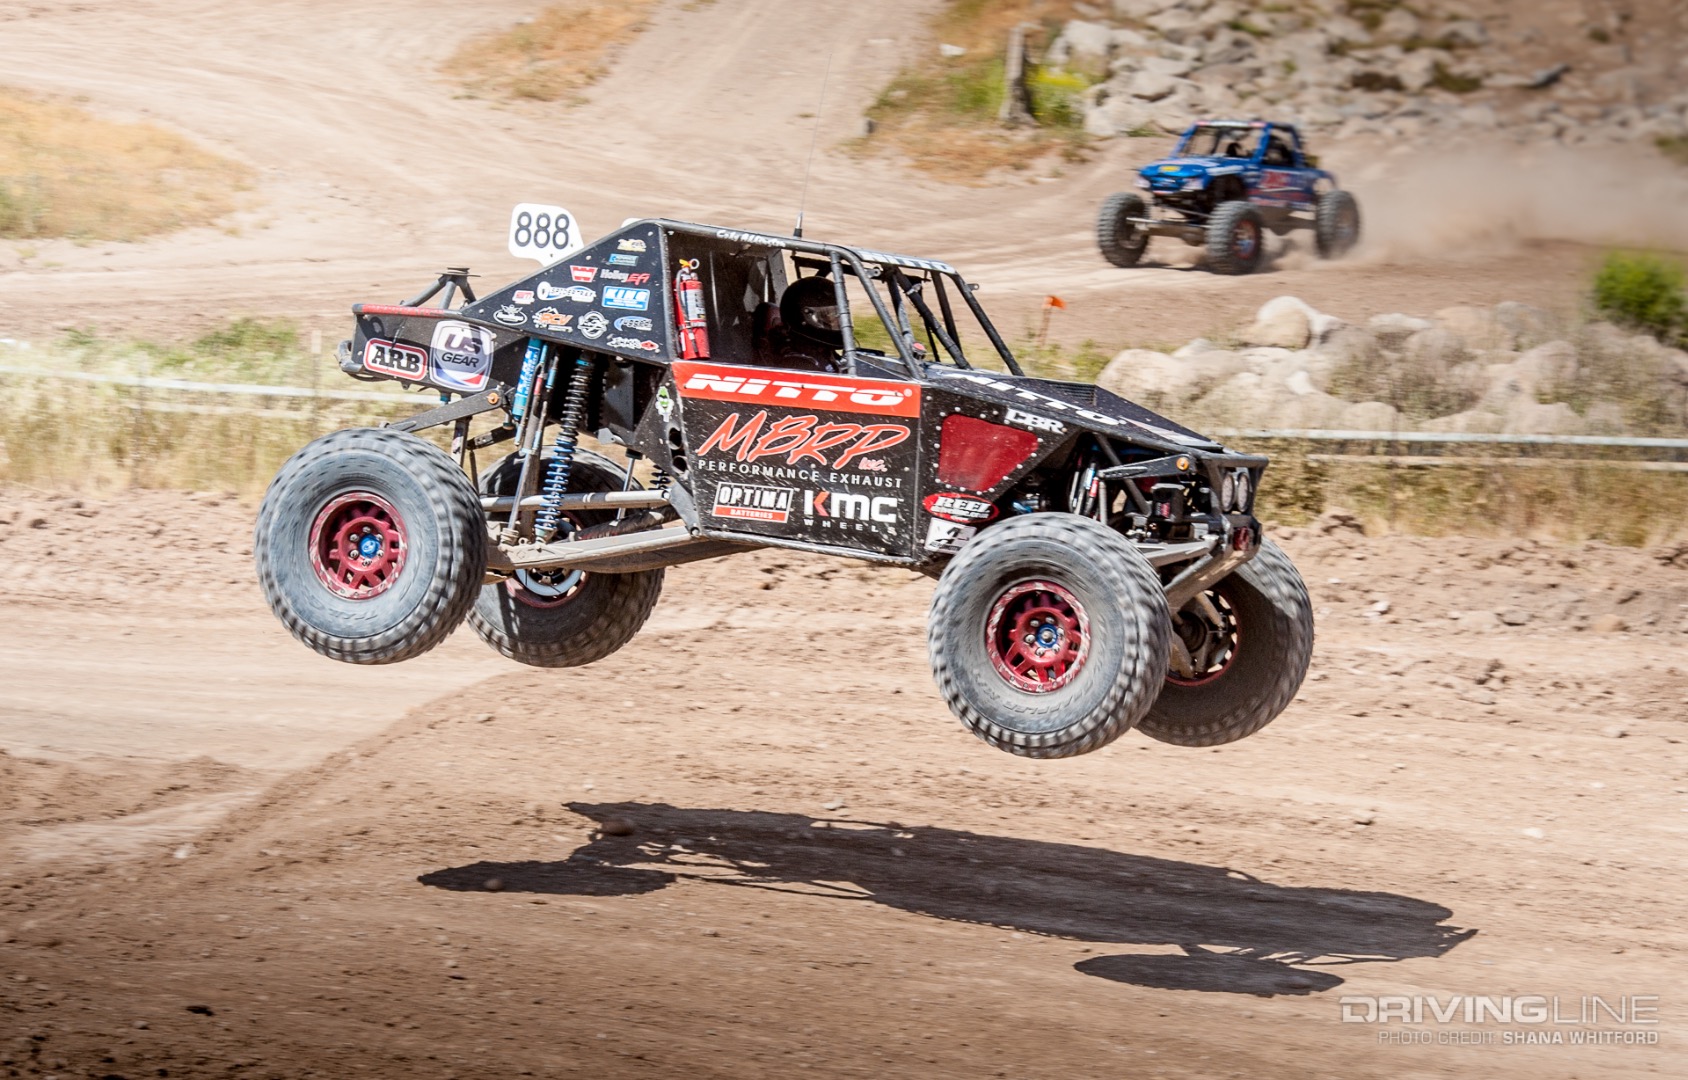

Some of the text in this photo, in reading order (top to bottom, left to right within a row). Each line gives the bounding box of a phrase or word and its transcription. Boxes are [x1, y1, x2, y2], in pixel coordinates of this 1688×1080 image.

[513, 211, 570, 250] 888
[444, 333, 483, 354] US
[371, 345, 420, 373] ARB
[441, 351, 479, 368] GEAR
[685, 374, 904, 406] NITTO
[1006, 408, 1066, 435] CBR
[696, 410, 910, 469] MBRP
[698, 460, 902, 488] PERFORMANCE EXHAUST
[719, 486, 787, 509] OPTIMA
[935, 496, 991, 513] REEL
[730, 508, 773, 520] BATTERIES
